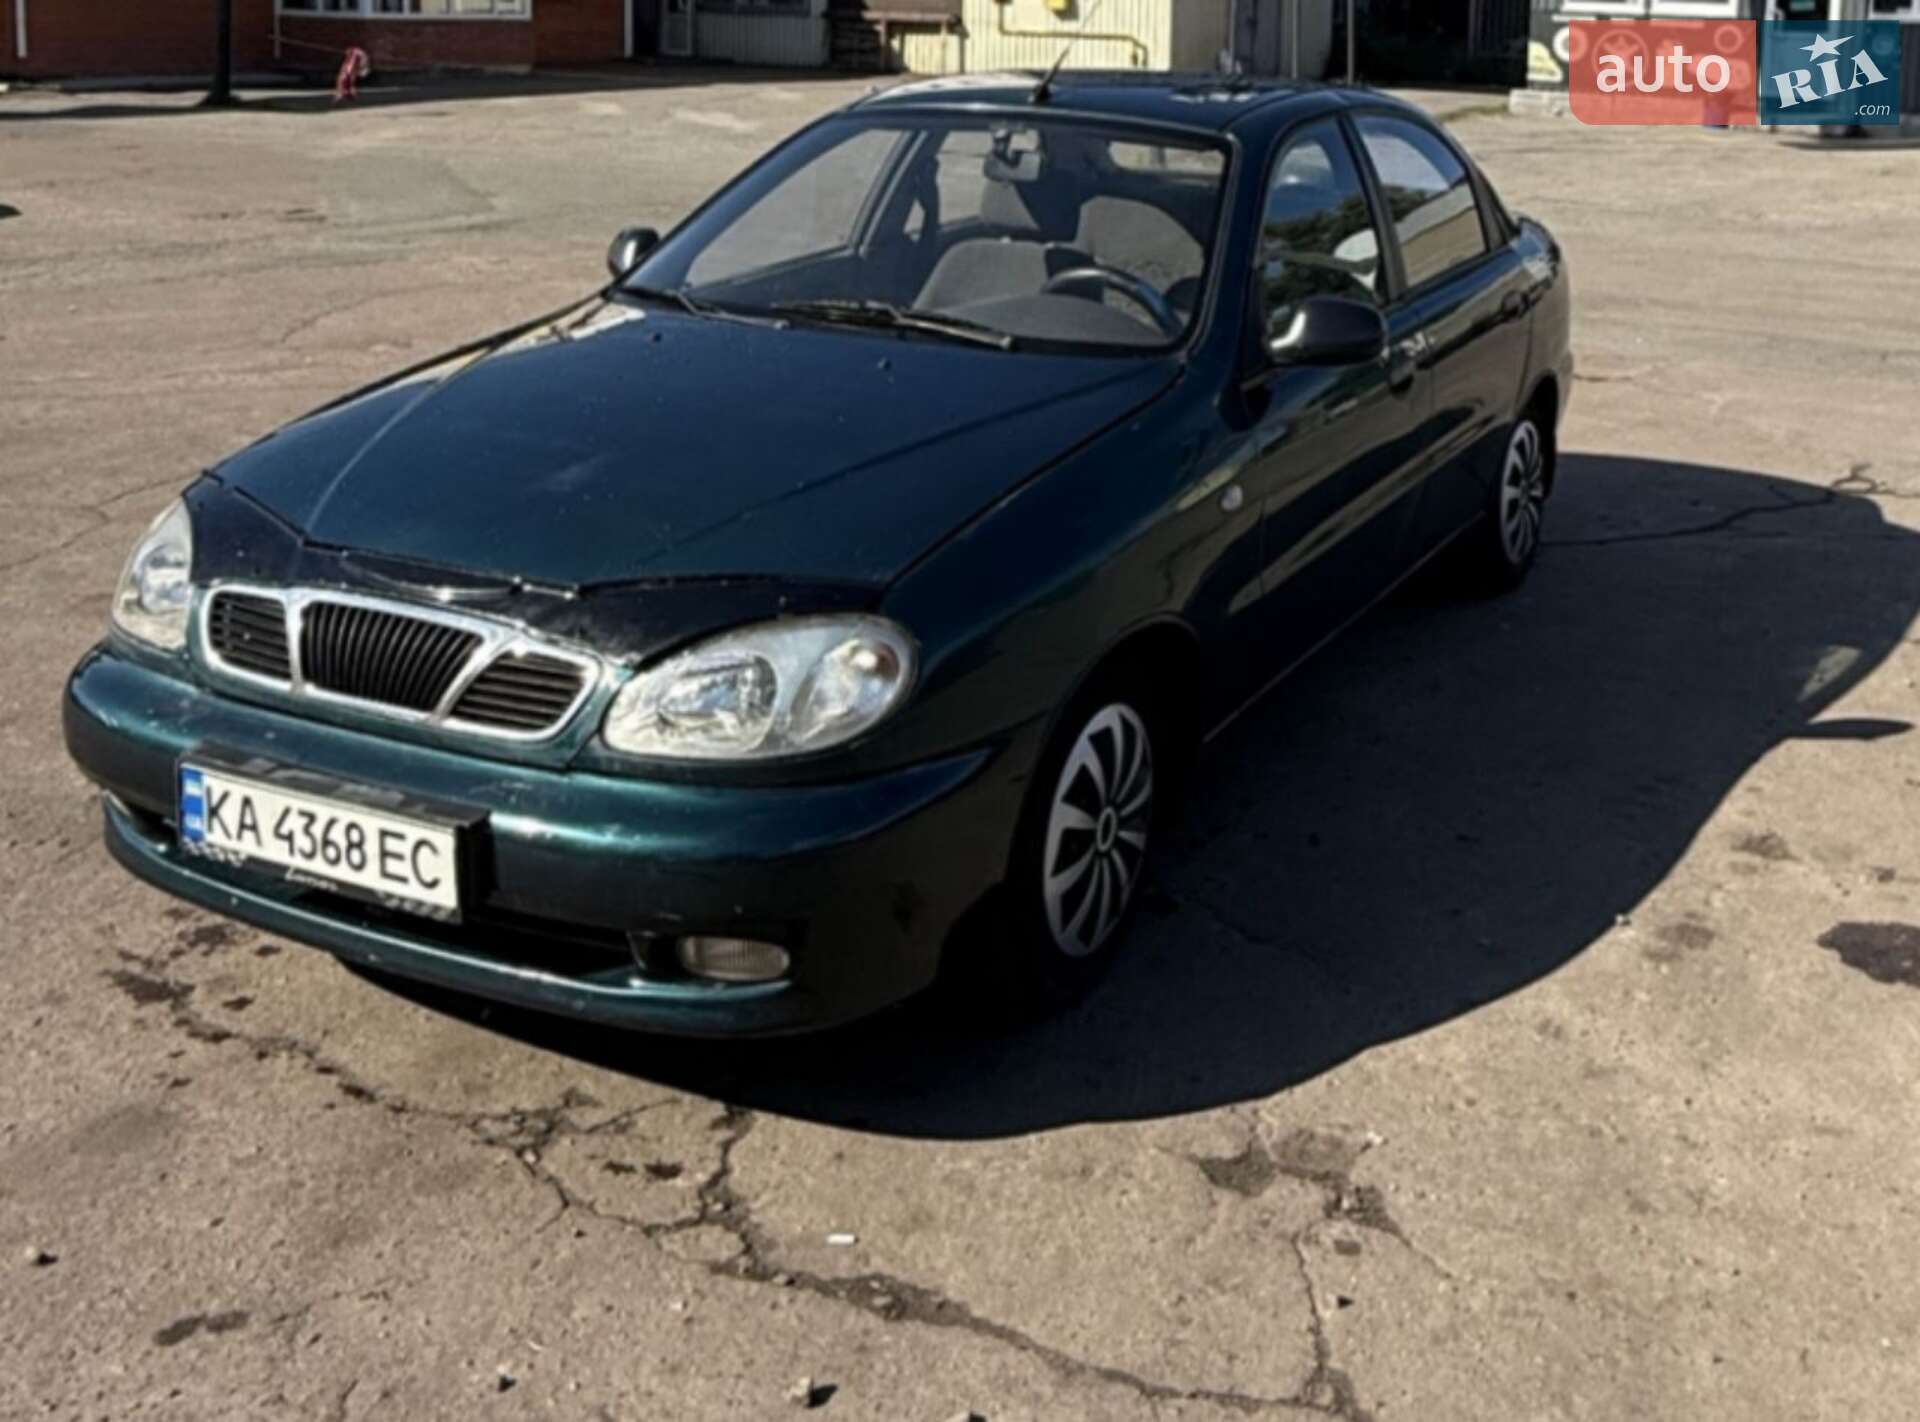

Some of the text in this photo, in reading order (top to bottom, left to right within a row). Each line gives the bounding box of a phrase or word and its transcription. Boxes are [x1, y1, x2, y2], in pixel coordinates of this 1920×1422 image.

[206, 785, 263, 847] KA
[273, 806, 367, 872] 4368
[378, 828, 441, 890] EC
